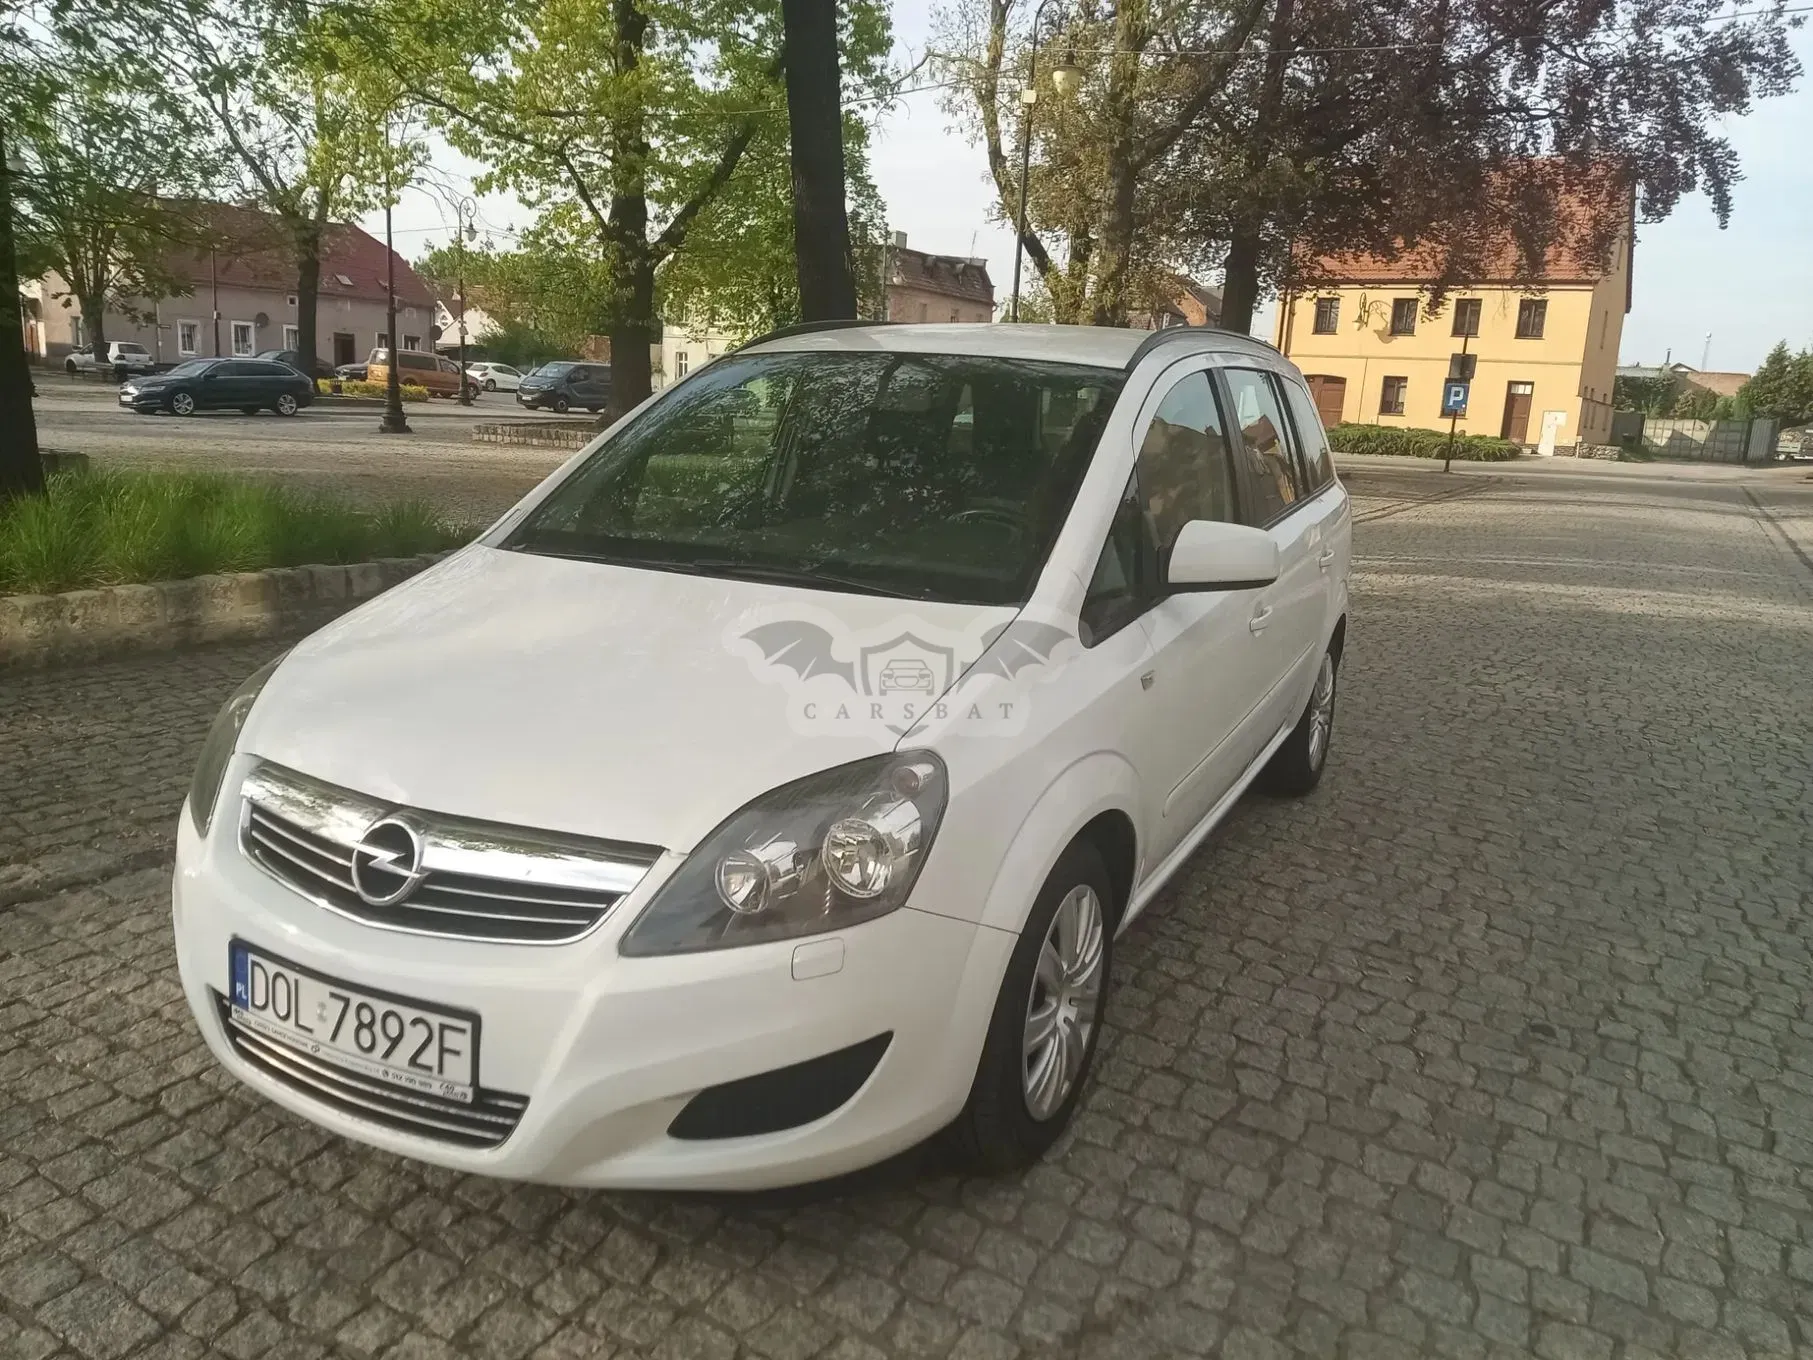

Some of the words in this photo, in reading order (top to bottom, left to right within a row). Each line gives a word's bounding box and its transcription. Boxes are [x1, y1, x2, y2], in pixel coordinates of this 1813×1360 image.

[1448, 386, 1464, 406] P
[236, 981, 248, 1000] PL
[250, 959, 314, 1034] DOL
[328, 991, 467, 1075] 7892F
